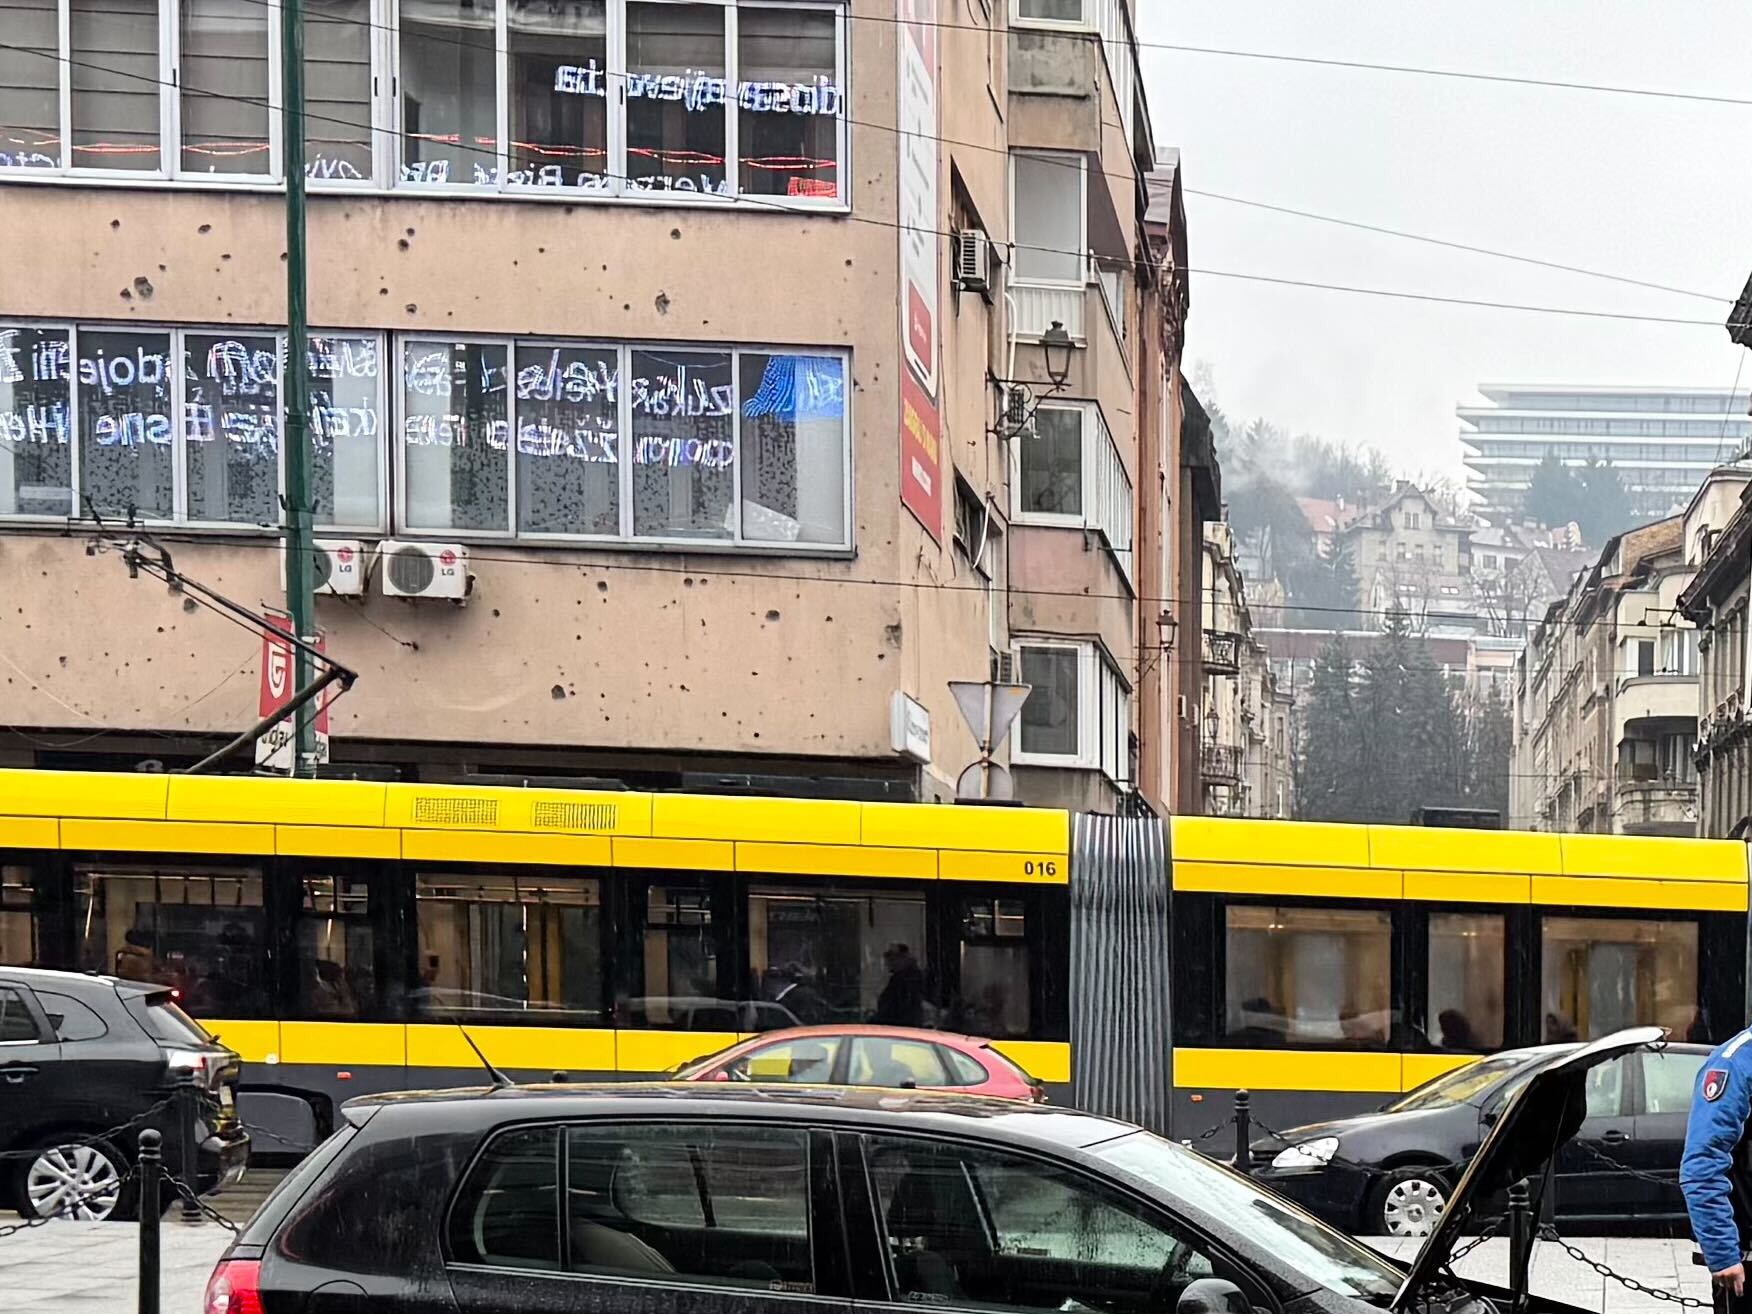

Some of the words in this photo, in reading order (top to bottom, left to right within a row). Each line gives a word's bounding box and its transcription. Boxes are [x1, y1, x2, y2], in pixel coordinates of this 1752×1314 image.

[339, 564, 352, 573] LG
[441, 568, 455, 576] LG
[1025, 860, 1056, 877] 016
